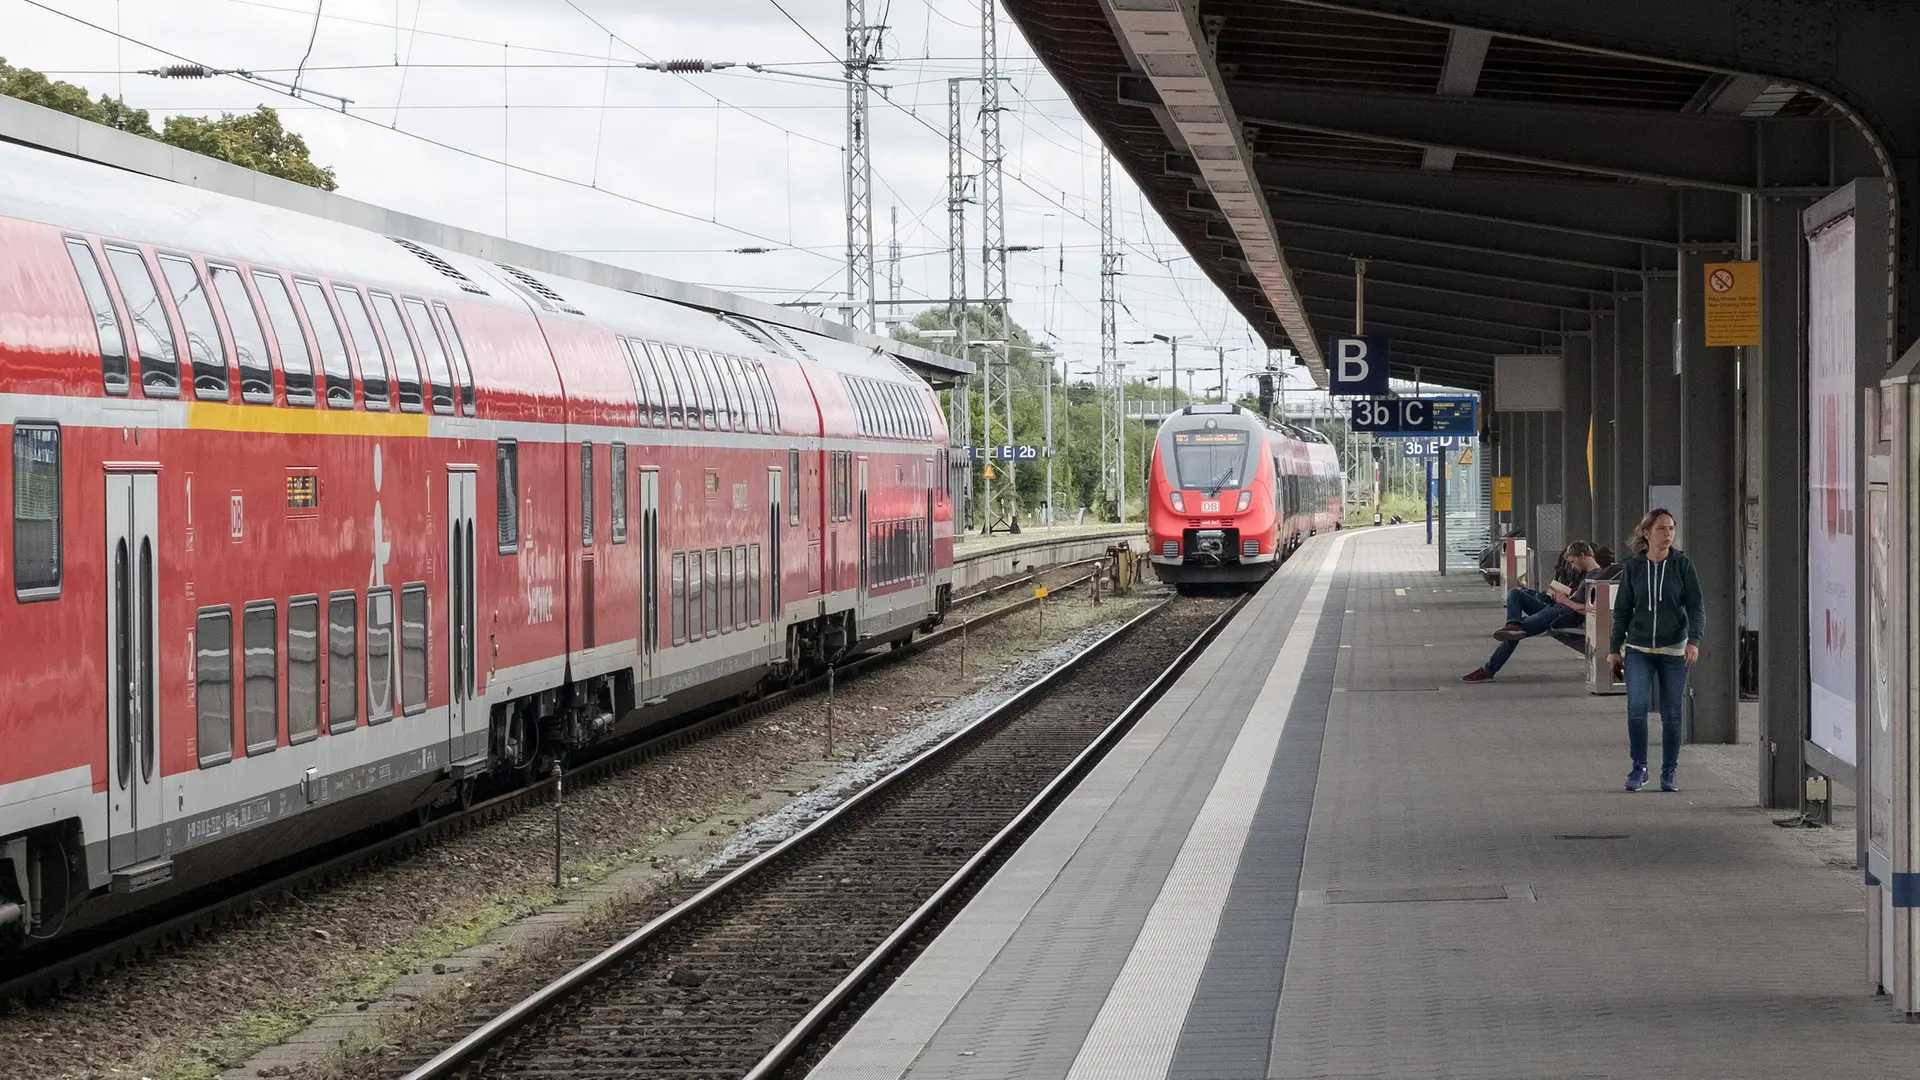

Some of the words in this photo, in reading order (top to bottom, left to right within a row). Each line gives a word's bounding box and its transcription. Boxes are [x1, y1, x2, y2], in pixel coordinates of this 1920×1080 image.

[1337, 339, 1369, 382] B
[1356, 400, 1390, 425] 3b
[1405, 400, 1424, 425] C
[1003, 446, 1012, 457] E
[1019, 445, 1036, 458] 2b
[1405, 441, 1423, 455] 3b
[1430, 441, 1439, 454] E
[186, 476, 192, 525] 1
[232, 499, 242, 534] DB
[1203, 502, 1218, 511] DB
[527, 574, 553, 625] Service
[187, 631, 194, 681] 2
